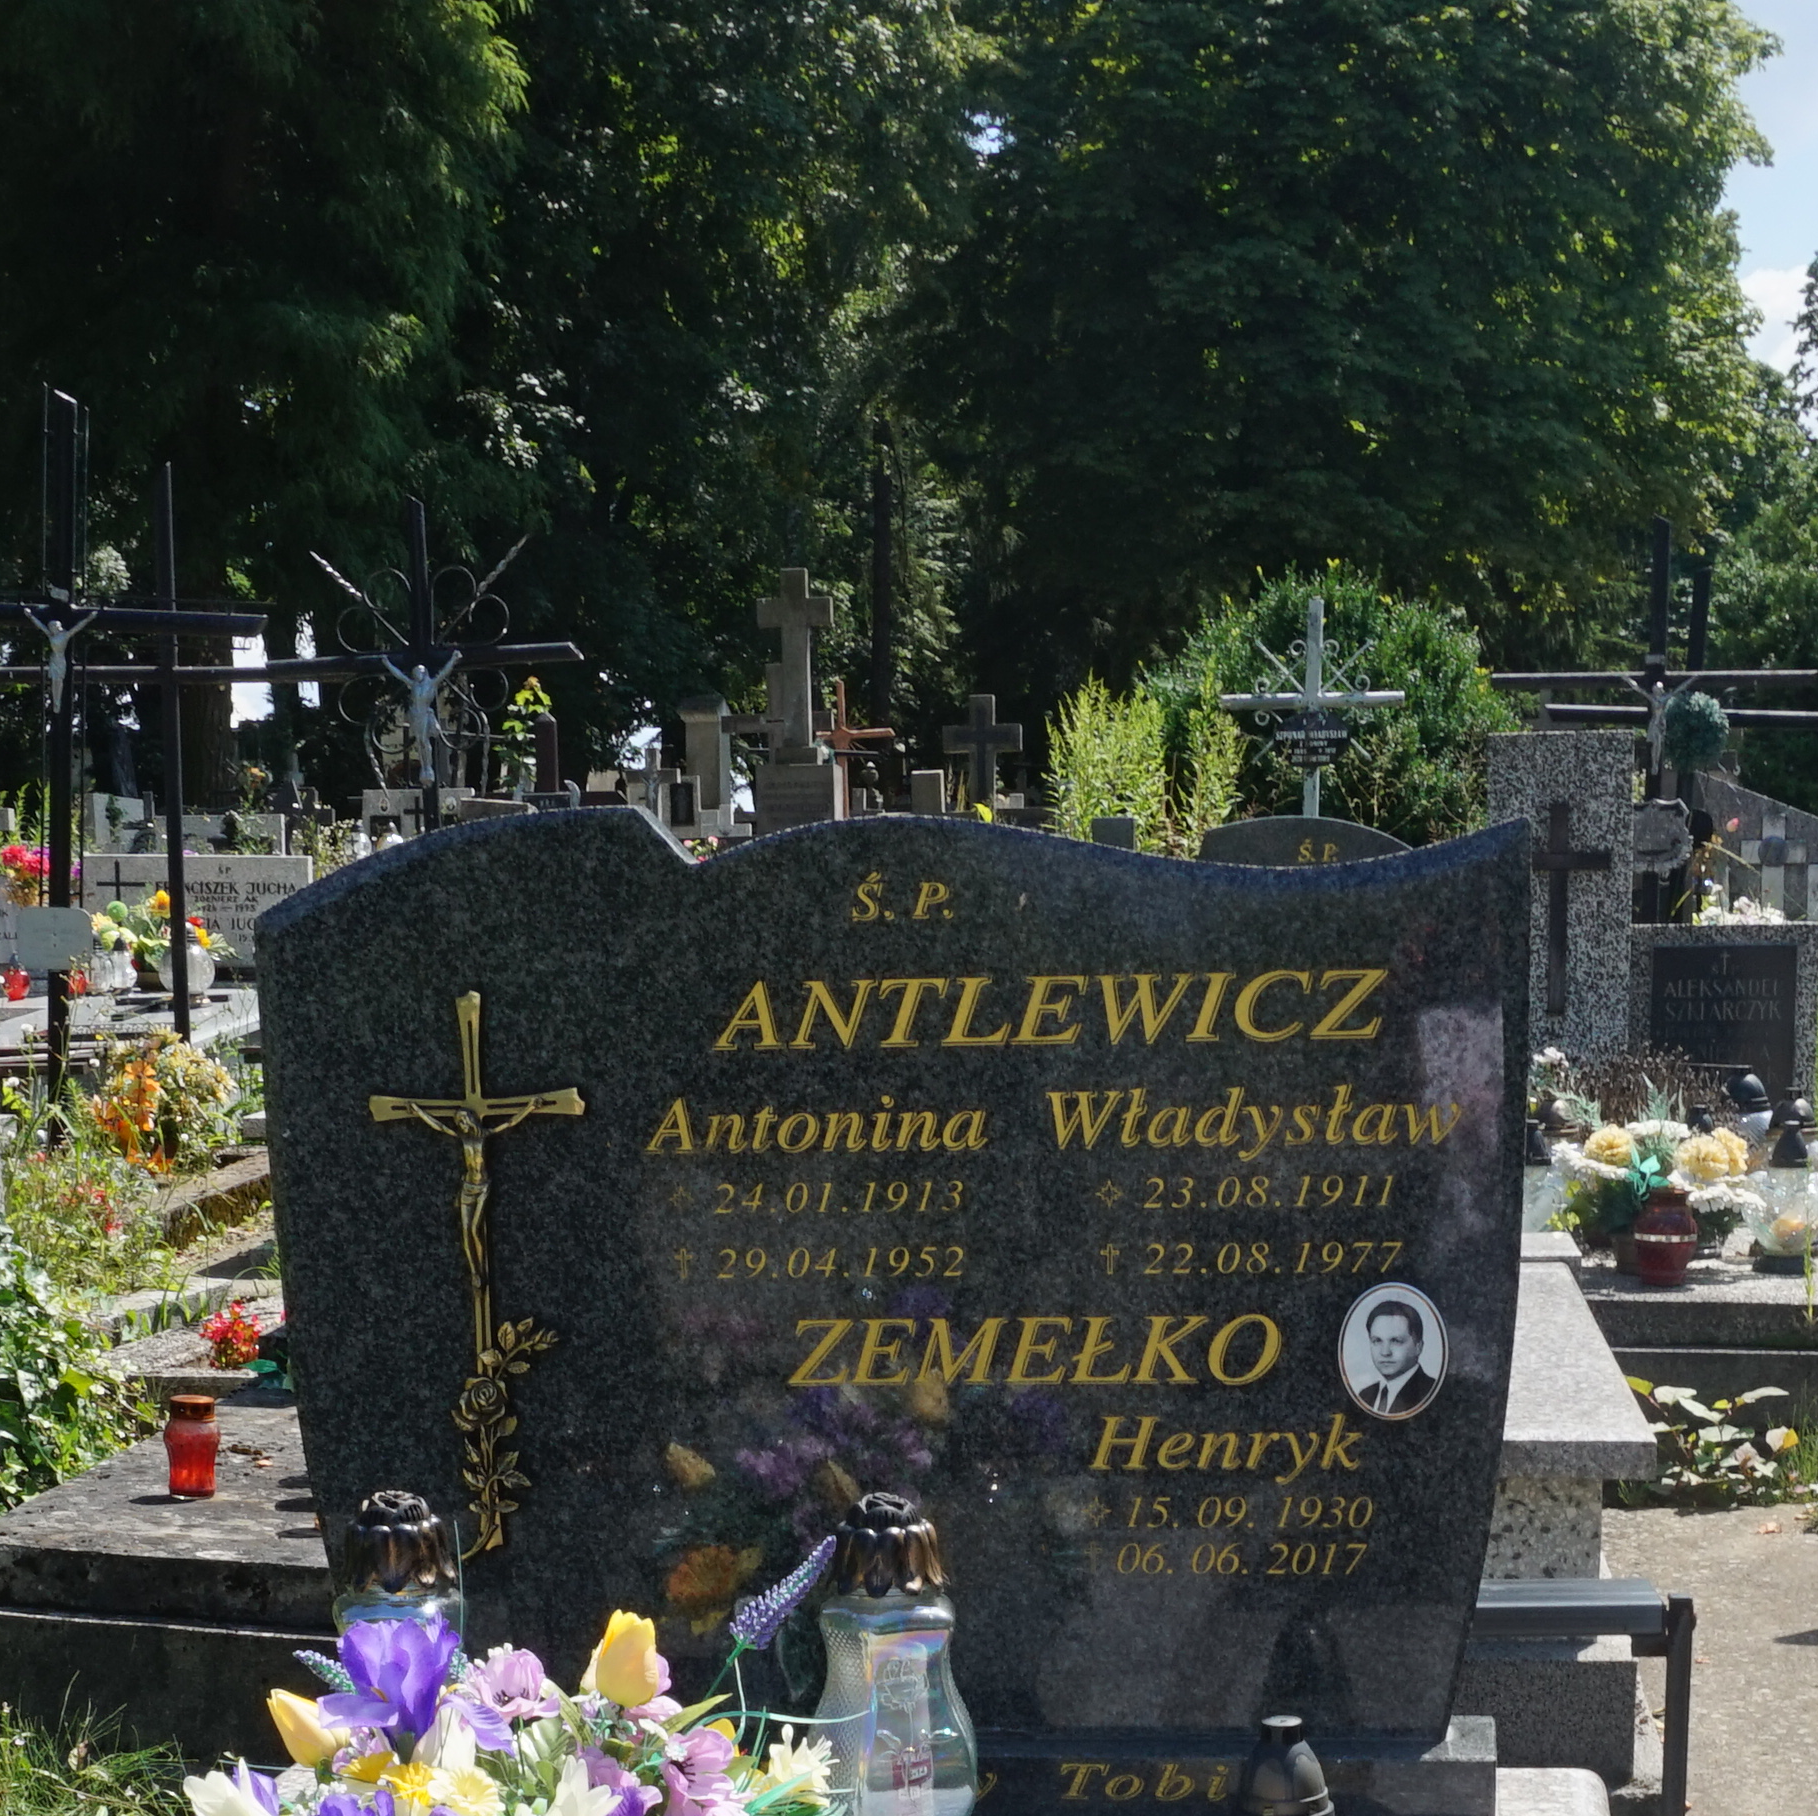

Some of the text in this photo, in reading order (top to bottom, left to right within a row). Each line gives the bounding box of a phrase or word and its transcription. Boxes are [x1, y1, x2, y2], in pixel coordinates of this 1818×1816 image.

[1323, 843, 1338, 863] P.
[246, 882, 297, 896] JUCHA
[851, 871, 955, 922] Ś. P.
[714, 968, 1389, 1052] ANTLEWICZ
[645, 1083, 1463, 1160] Antonina Władysław
[714, 1174, 1398, 1216] 24.01.1913 23.08.1911
[715, 1240, 1405, 1280] 29.04.1952 22.08.1977
[787, 1312, 1283, 1389] ZEMEŁKO
[1089, 1413, 1363, 1485] Henryk
[1126, 1495, 1374, 1529] 15. 09. 1930
[1116, 1542, 1368, 1575] 06. 06. 2017
